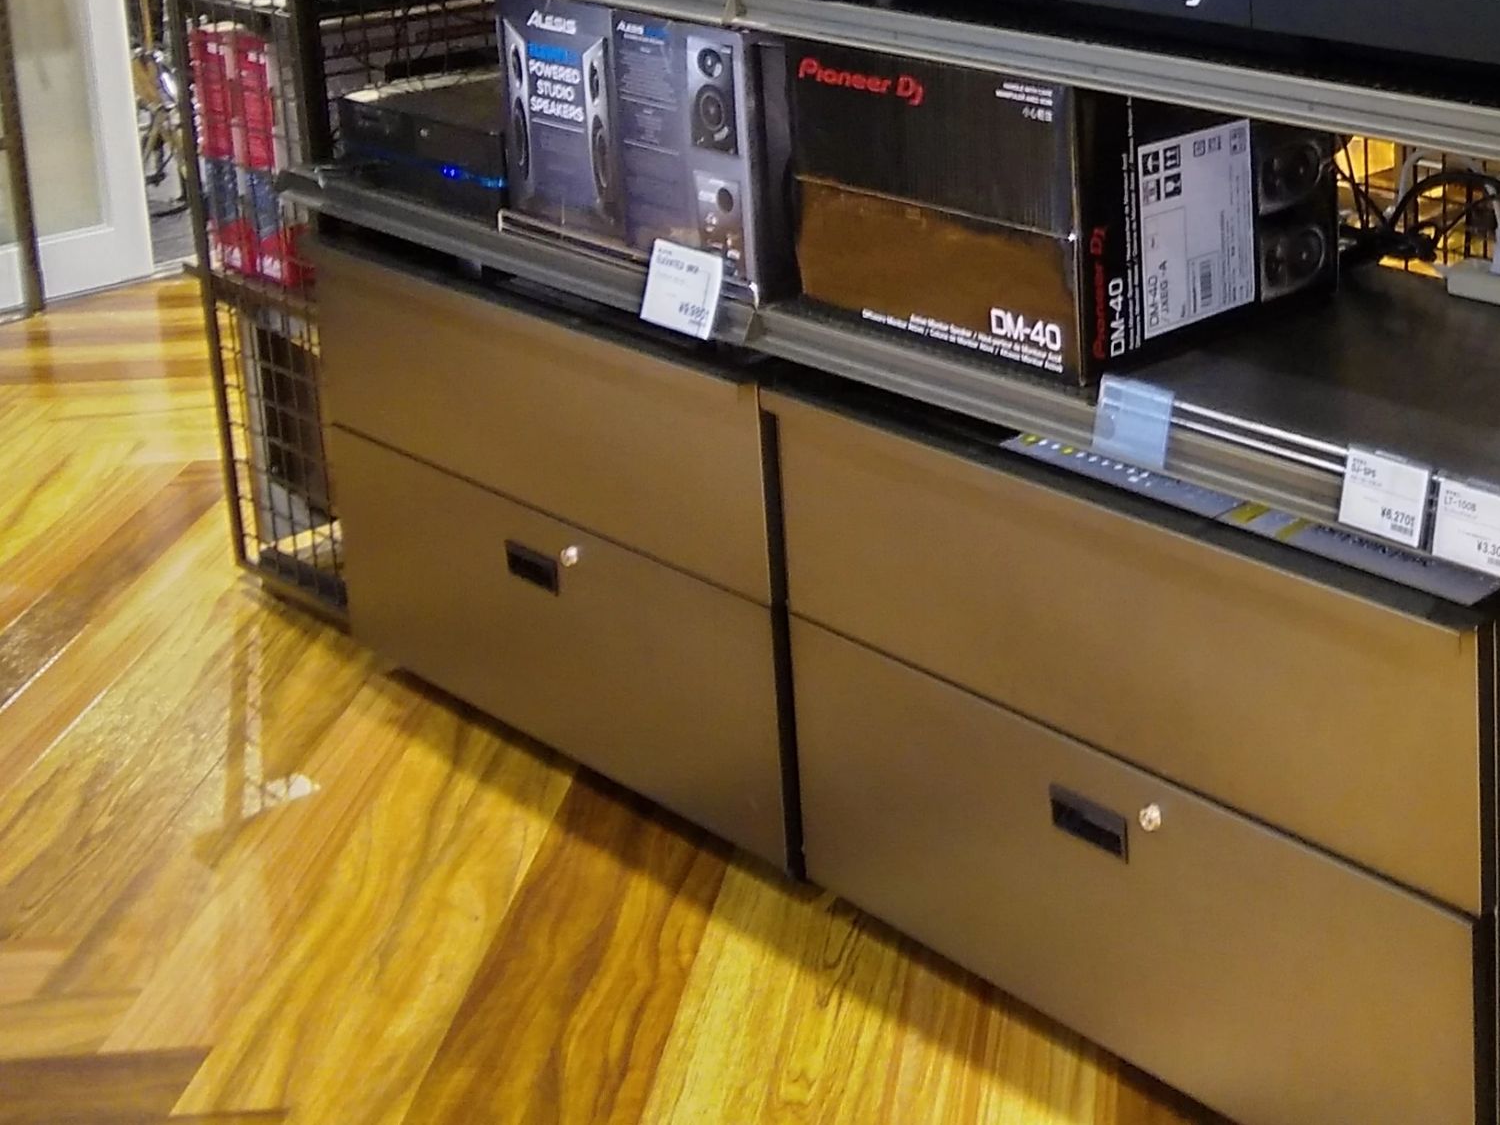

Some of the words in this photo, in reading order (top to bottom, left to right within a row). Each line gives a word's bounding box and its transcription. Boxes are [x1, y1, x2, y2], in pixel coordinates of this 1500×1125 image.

[526, 10, 577, 35] ALESIS
[528, 59, 580, 84] POWERED
[798, 56, 891, 96] Pioneer
[537, 81, 574, 101] STUDIO
[530, 96, 584, 122] SPEAKERS
[990, 307, 1062, 351] DM-40
[1109, 277, 1124, 358] DM-40
